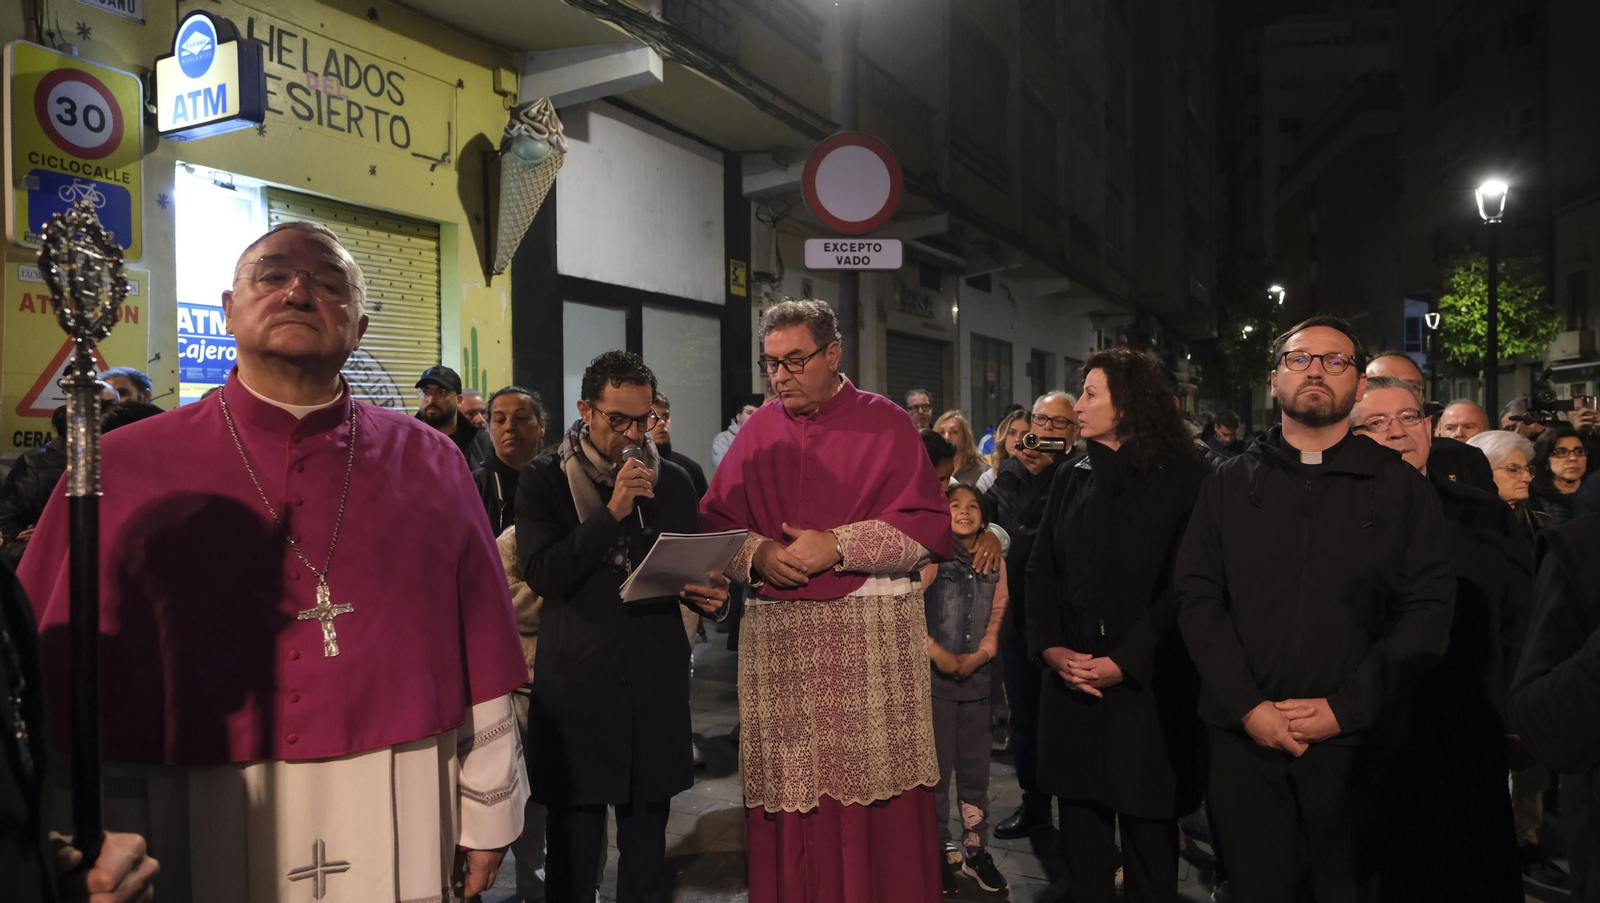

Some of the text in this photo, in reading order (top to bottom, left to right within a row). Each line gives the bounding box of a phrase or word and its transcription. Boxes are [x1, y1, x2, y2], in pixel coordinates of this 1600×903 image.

[247, 17, 405, 106] HELADOS
[307, 71, 349, 100] DEL
[55, 96, 106, 133] 30
[172, 82, 227, 125] ATM
[264, 72, 410, 149] ESIERTO
[28, 151, 131, 184] CICLOCALLE
[823, 242, 882, 253] EXCEPTO
[836, 255, 870, 266] VADO
